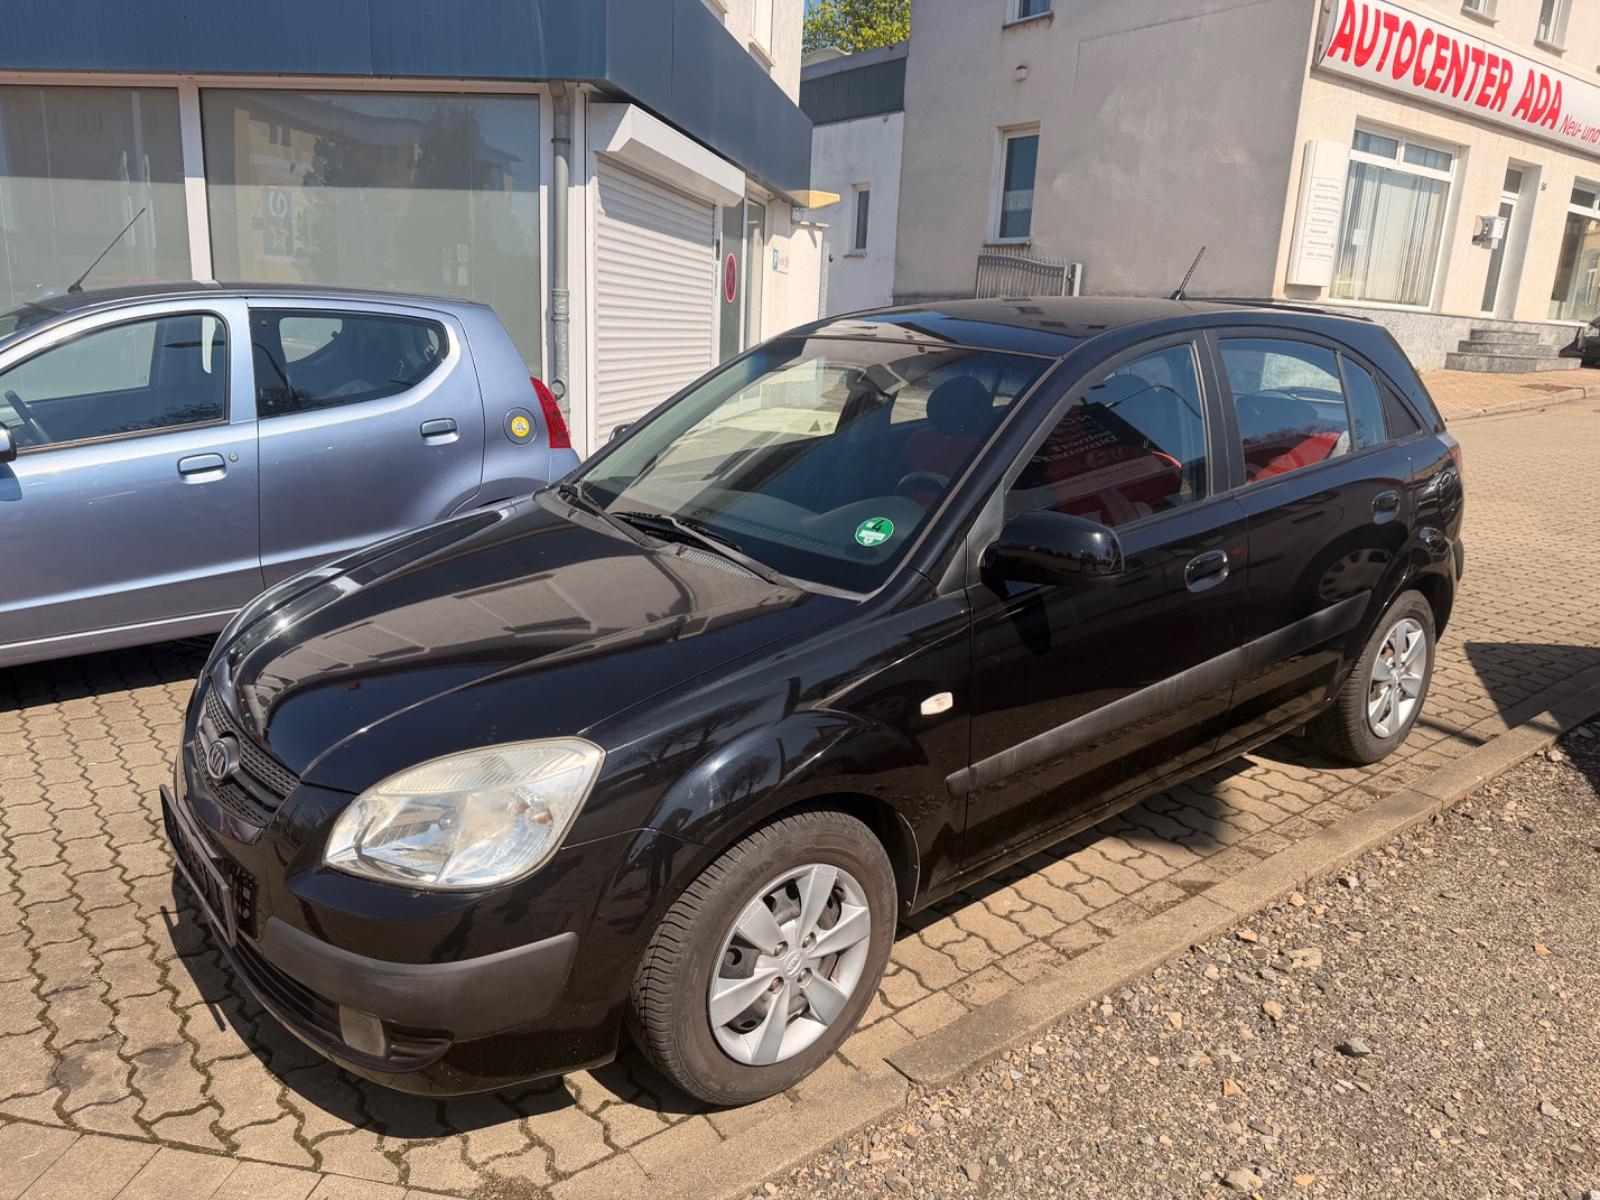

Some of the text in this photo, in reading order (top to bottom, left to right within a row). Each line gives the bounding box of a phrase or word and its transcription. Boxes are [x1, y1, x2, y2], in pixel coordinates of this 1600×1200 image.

[1327, 0, 1563, 130] AUTOCENTER ADA
[1560, 114, 1581, 136] Neu-
[871, 519, 885, 533] 4
